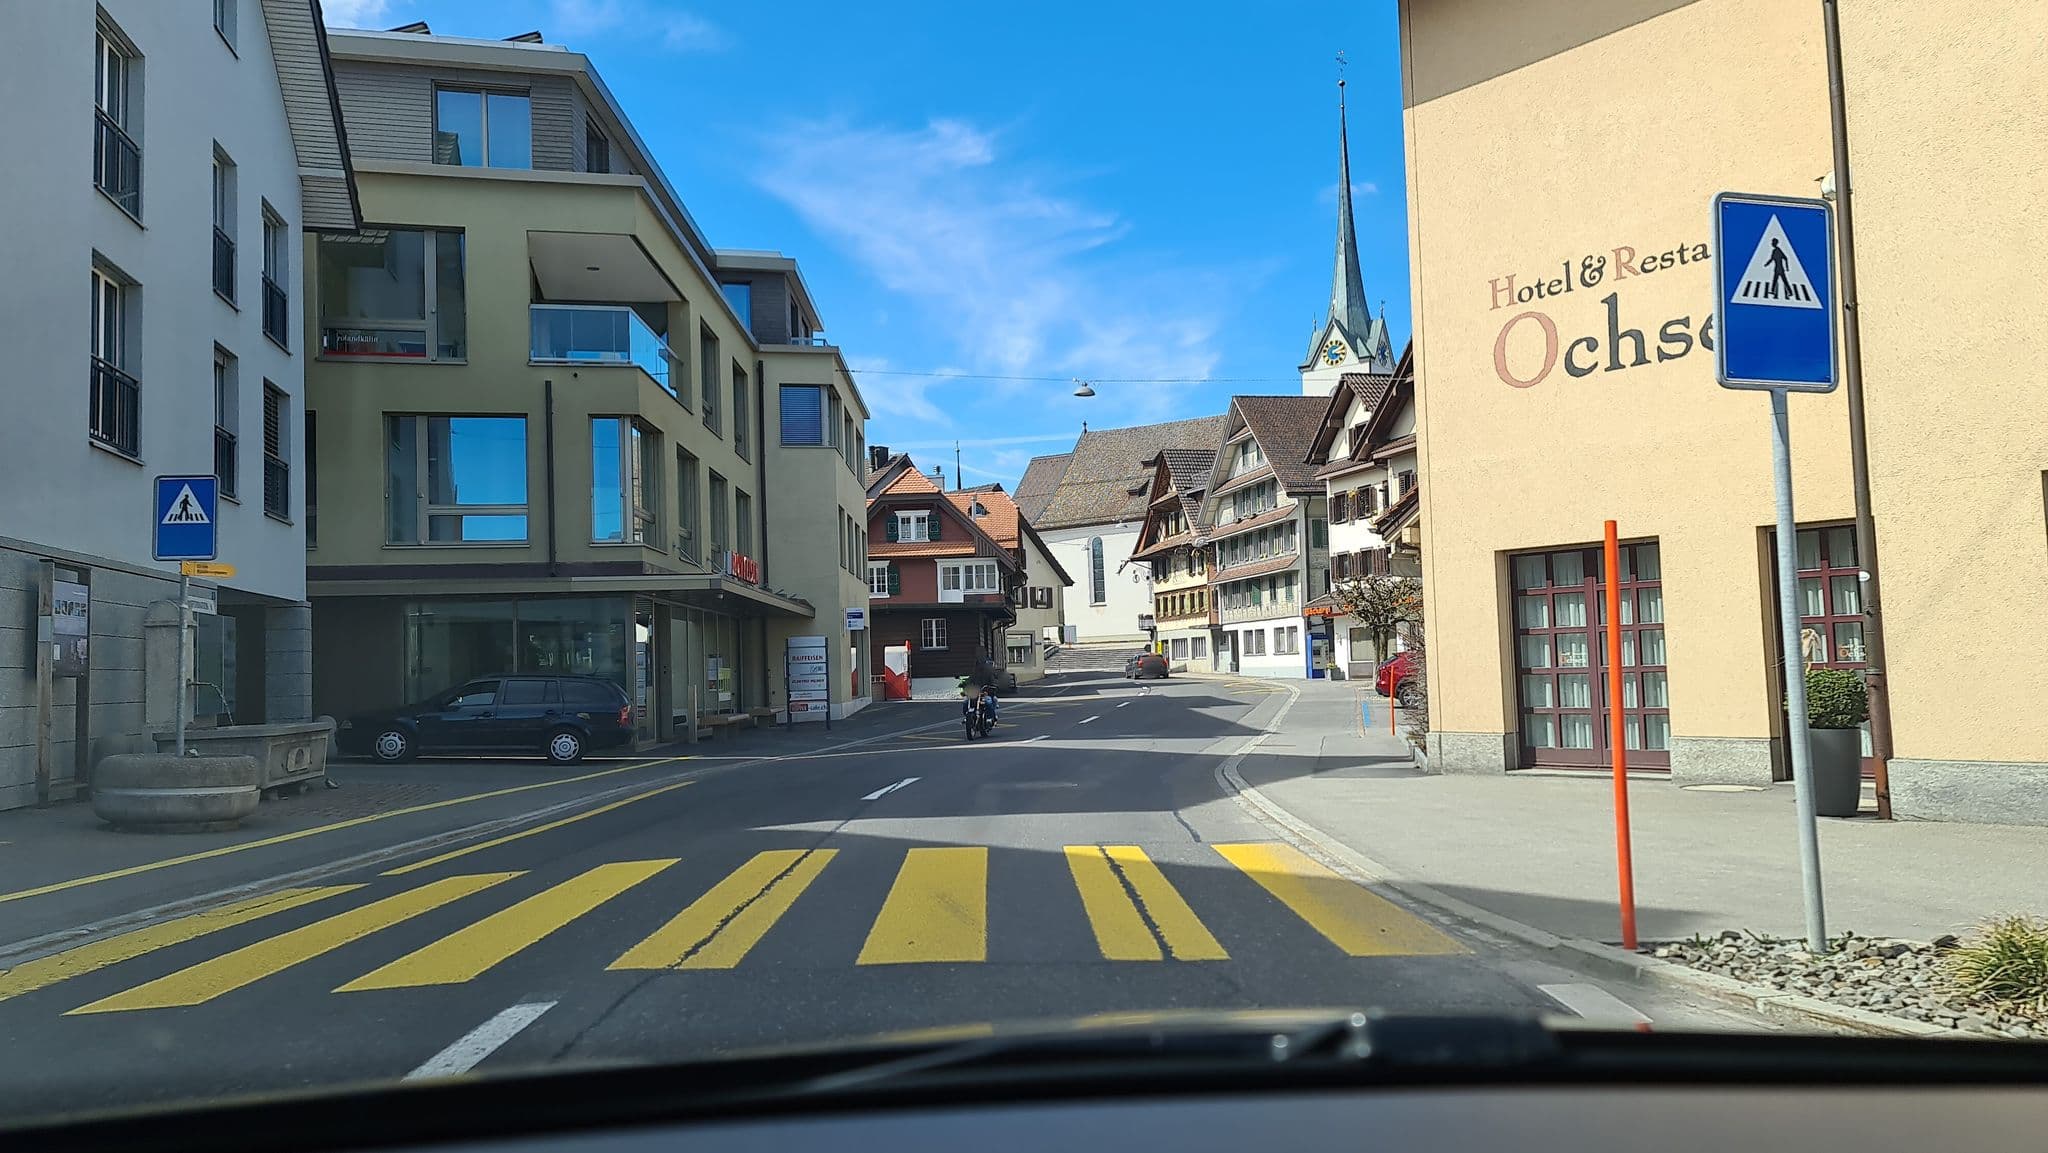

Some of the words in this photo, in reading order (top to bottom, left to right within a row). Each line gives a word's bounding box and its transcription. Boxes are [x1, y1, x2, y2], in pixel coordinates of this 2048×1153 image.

[1488, 260, 1575, 311] Hotel
[1580, 255, 1606, 288] &
[1611, 242, 1712, 281] Resta
